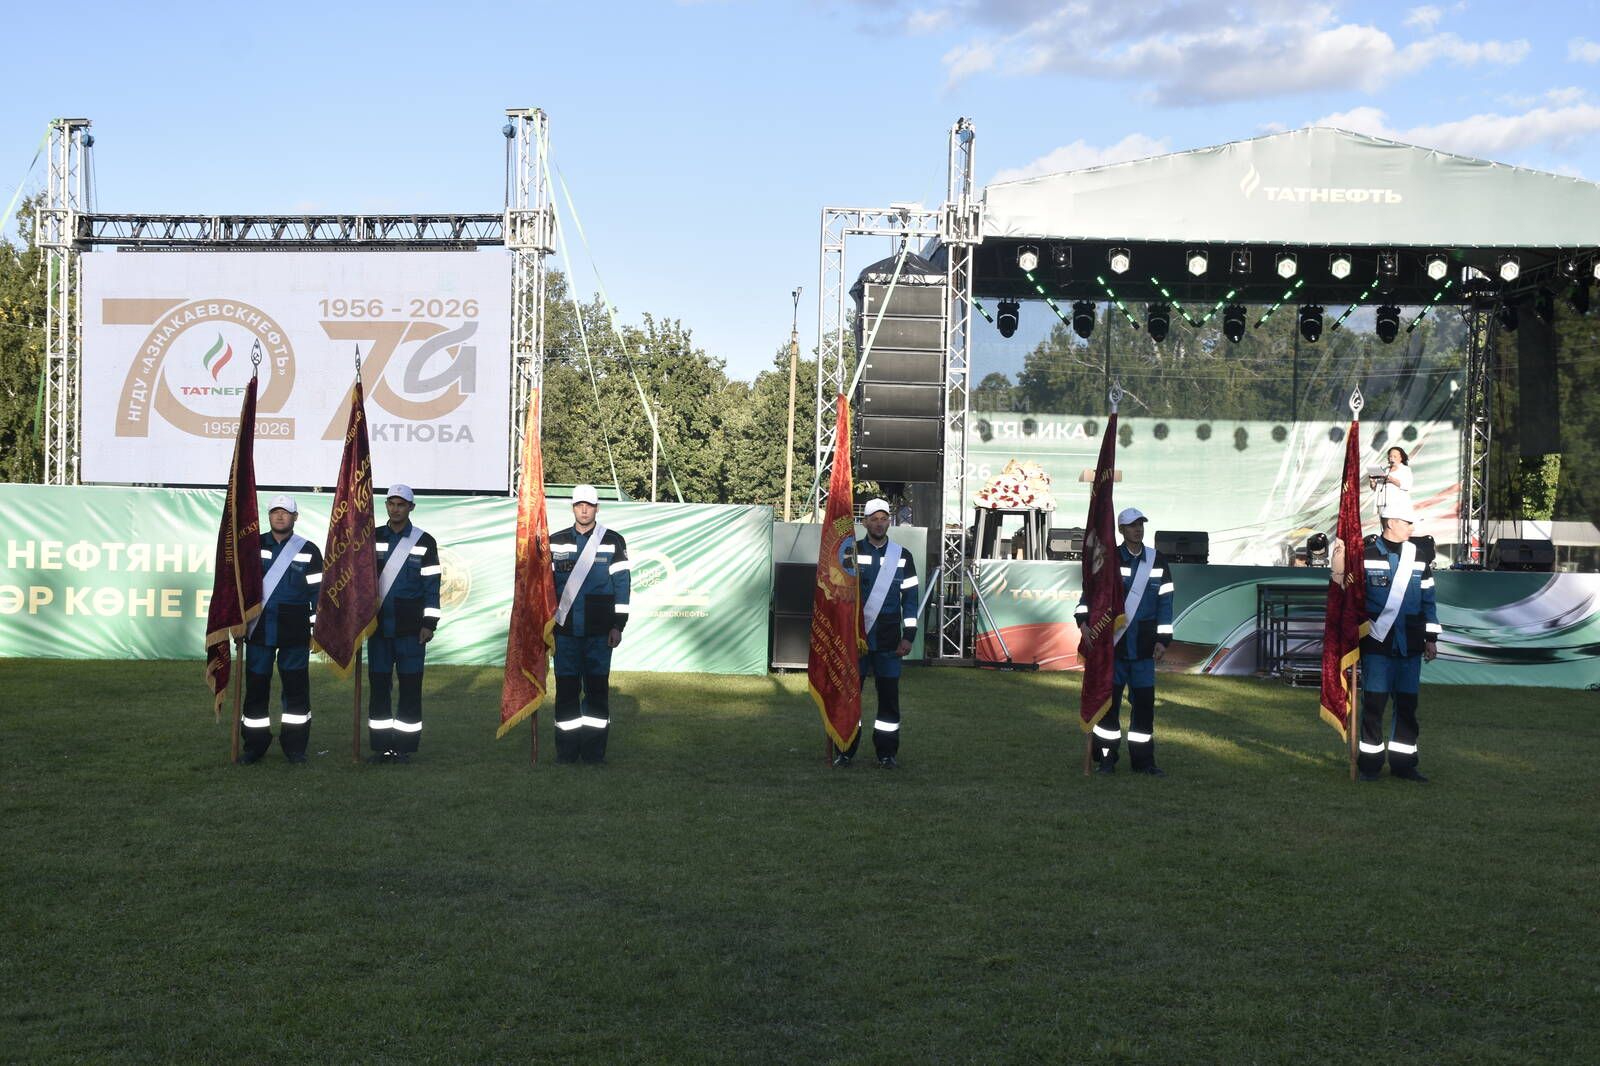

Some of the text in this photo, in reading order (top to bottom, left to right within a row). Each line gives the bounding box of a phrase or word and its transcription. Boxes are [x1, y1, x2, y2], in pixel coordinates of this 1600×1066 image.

[1264, 187, 1402, 203] ТАТНЕФТЬ
[318, 299, 384, 318] 1956
[410, 299, 479, 318] 2026
[128, 377, 148, 421] НГДУ
[180, 386, 246, 396] TATNEF
[7, 539, 215, 573] НЕФТЯНИ
[65, 586, 183, 618] КӨНЕ
